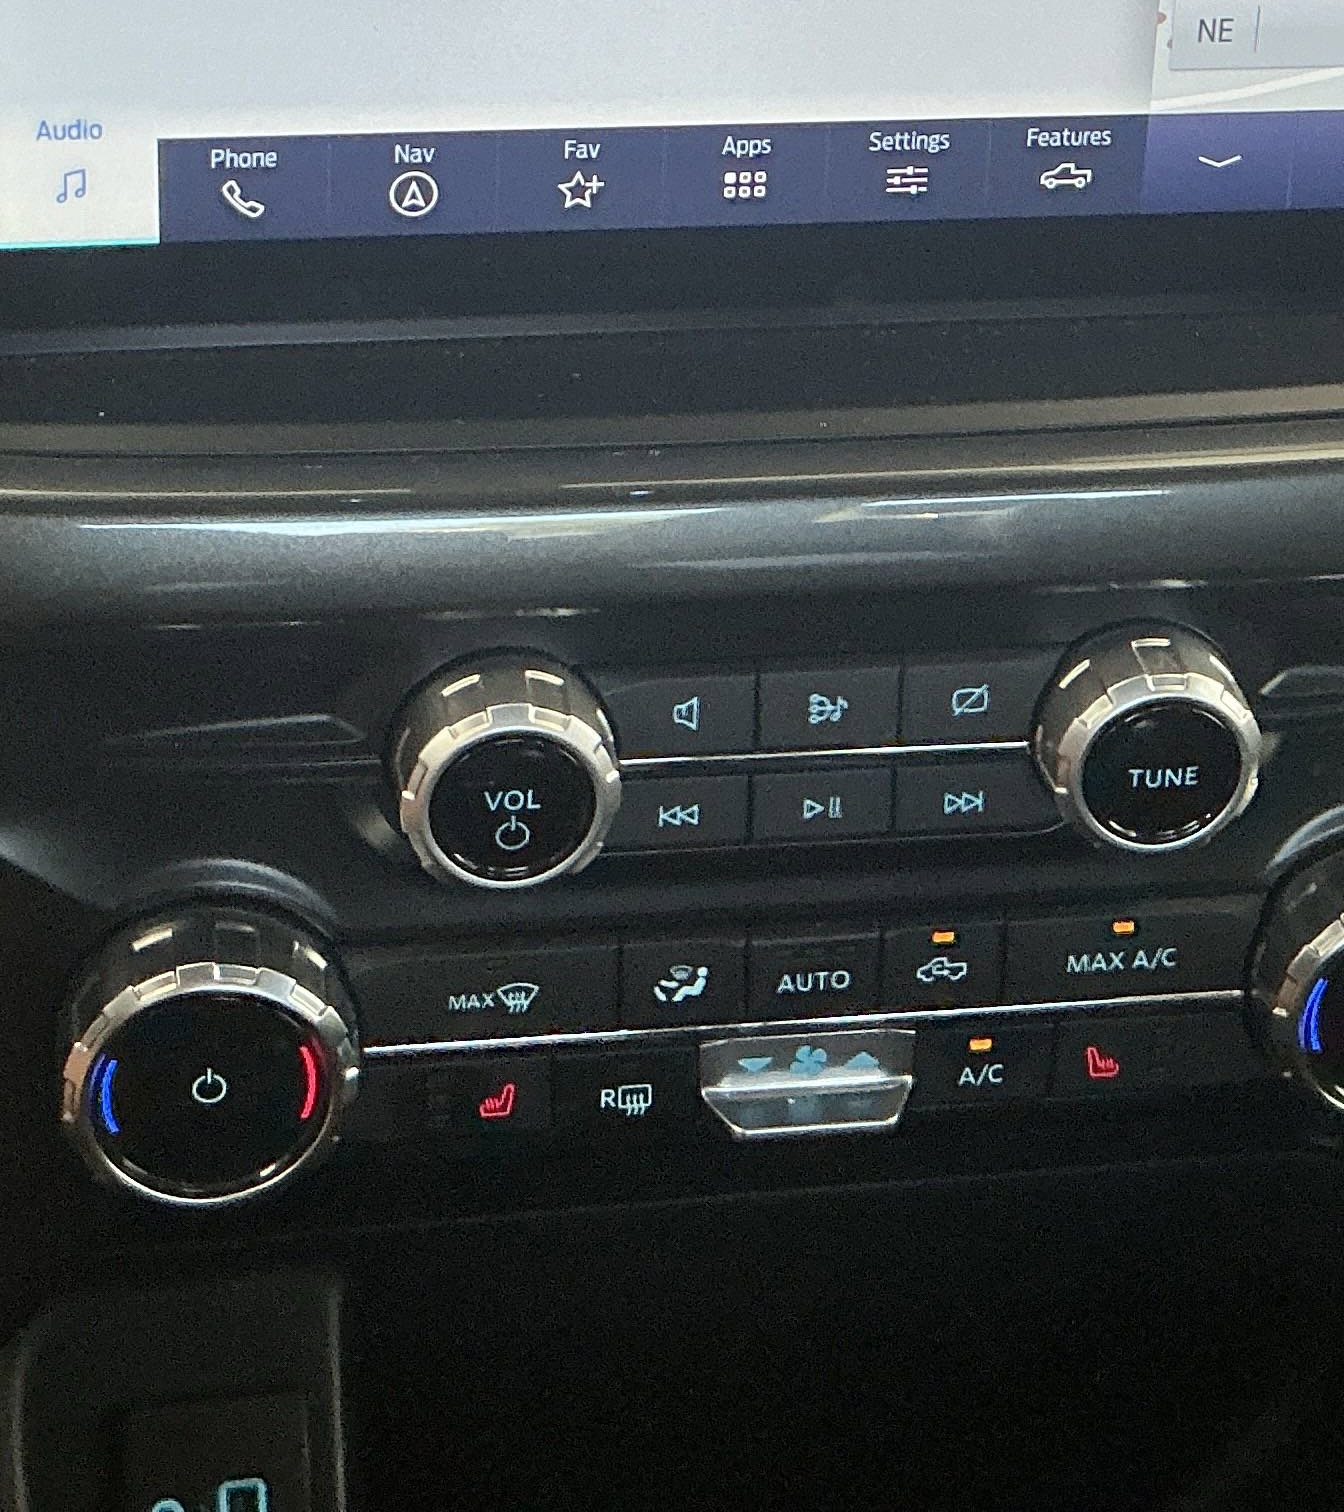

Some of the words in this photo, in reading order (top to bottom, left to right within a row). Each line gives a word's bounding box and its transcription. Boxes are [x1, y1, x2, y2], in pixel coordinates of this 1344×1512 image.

[1197, 17, 1234, 44] NE
[35, 118, 104, 142] Audio
[868, 130, 950, 154] Settings
[1026, 126, 1113, 149] Features
[210, 147, 278, 170] Phone
[393, 144, 436, 164] Nav
[563, 139, 601, 159] Fav
[721, 135, 772, 159] Apps
[1127, 765, 1201, 790] TUNE
[484, 791, 542, 811] VOL
[1066, 951, 1126, 974] MAX
[1130, 947, 1178, 970] A/C
[777, 970, 850, 994] AUTO
[449, 993, 495, 1011] MAX
[958, 1062, 1004, 1086] A/C
[600, 1090, 615, 1109] R
